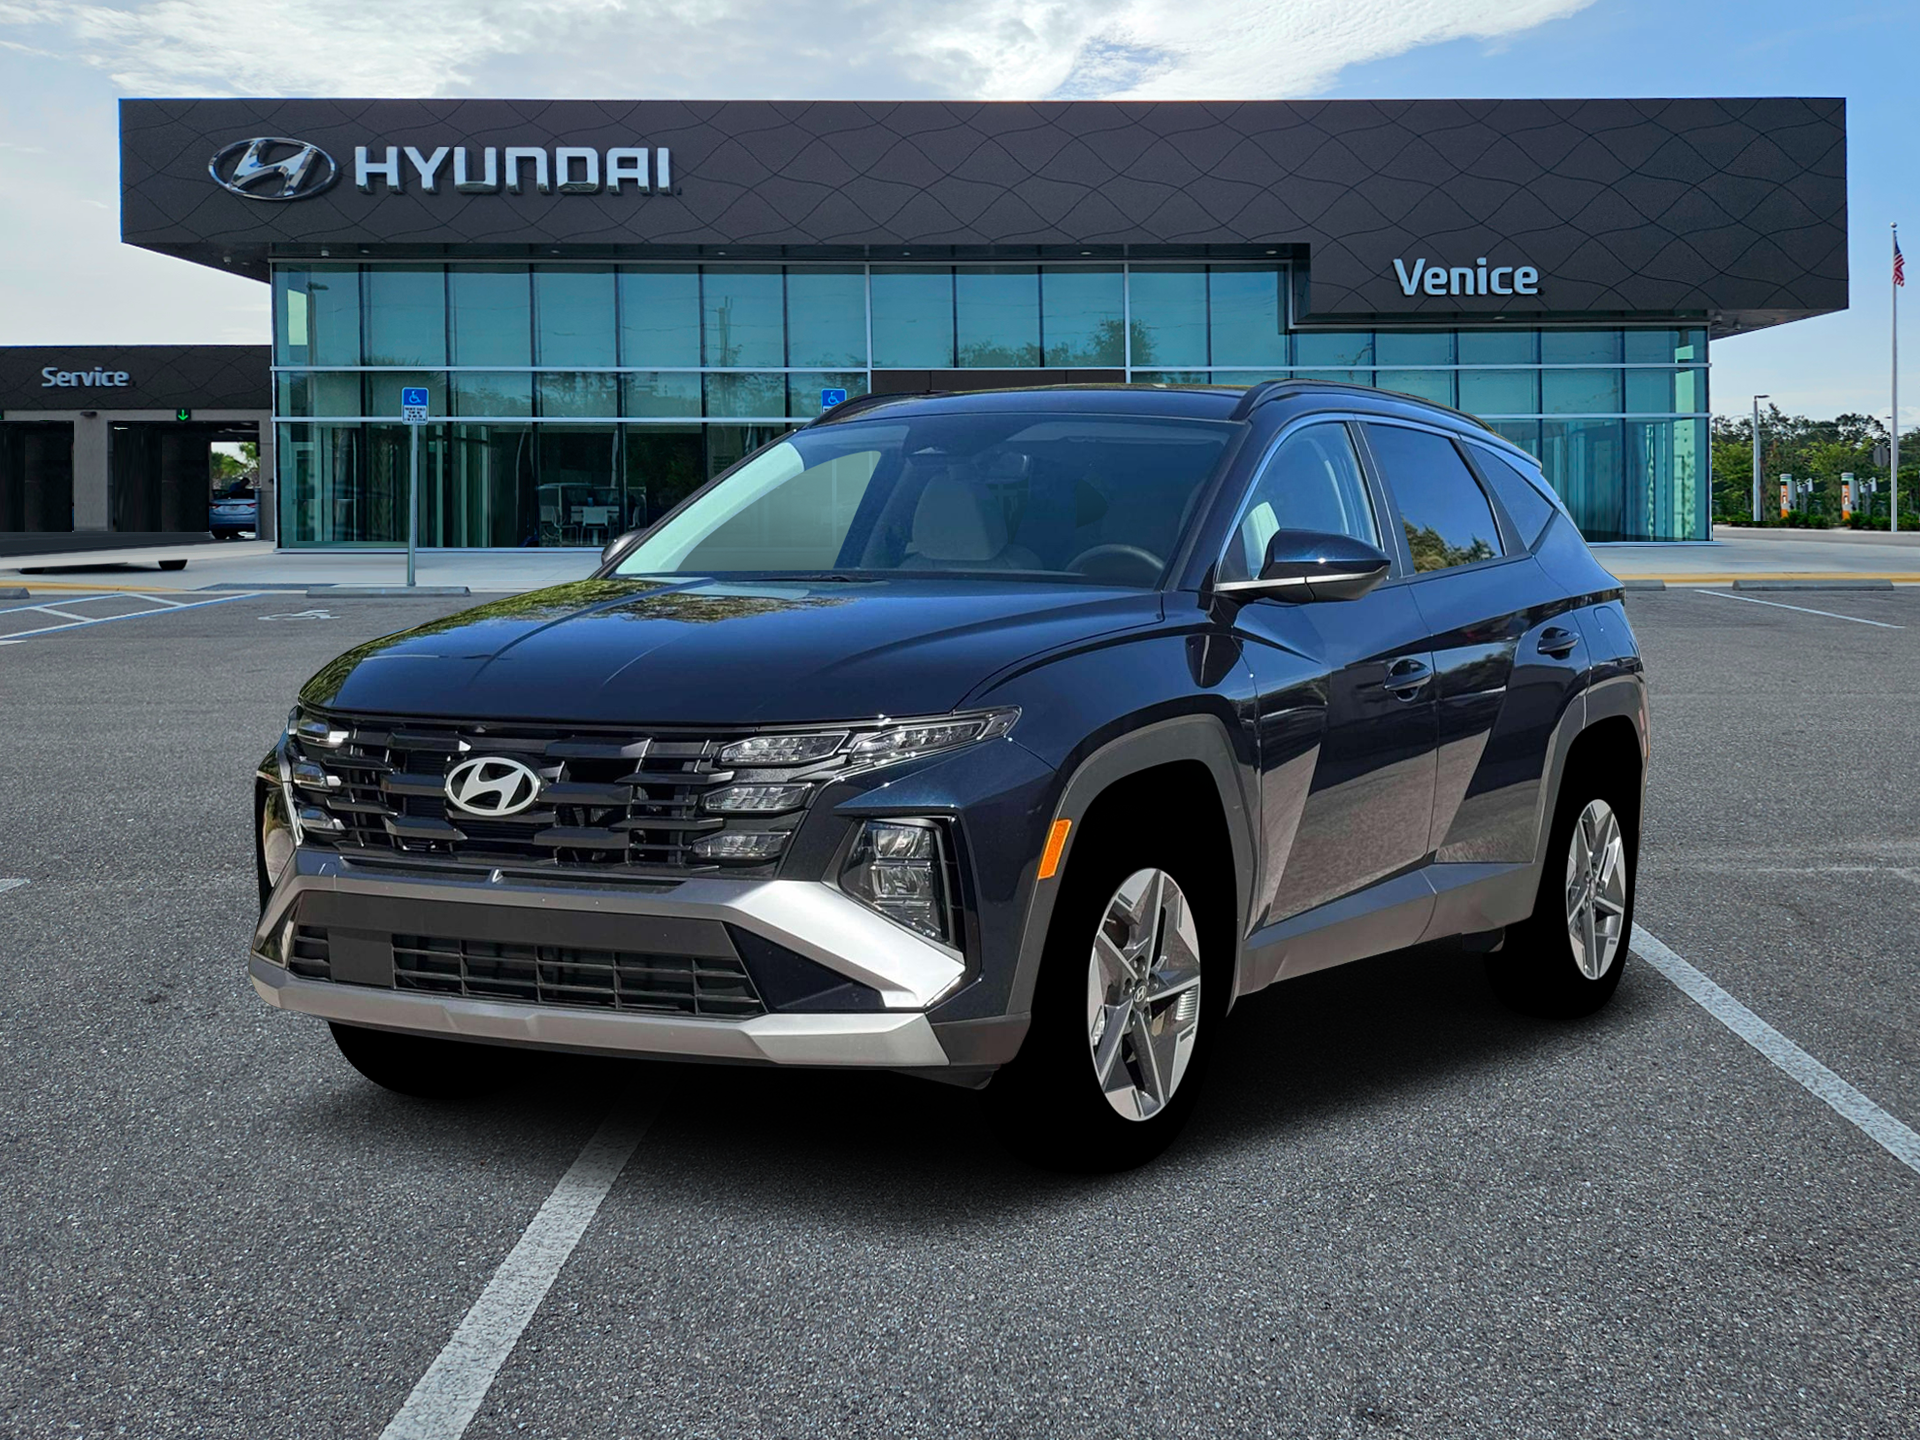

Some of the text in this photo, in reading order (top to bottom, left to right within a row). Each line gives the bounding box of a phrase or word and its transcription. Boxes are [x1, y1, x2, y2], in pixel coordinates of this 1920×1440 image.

[354, 146, 671, 193] HYUNDAI
[1393, 257, 1538, 295] Venice
[41, 366, 129, 387] Service
